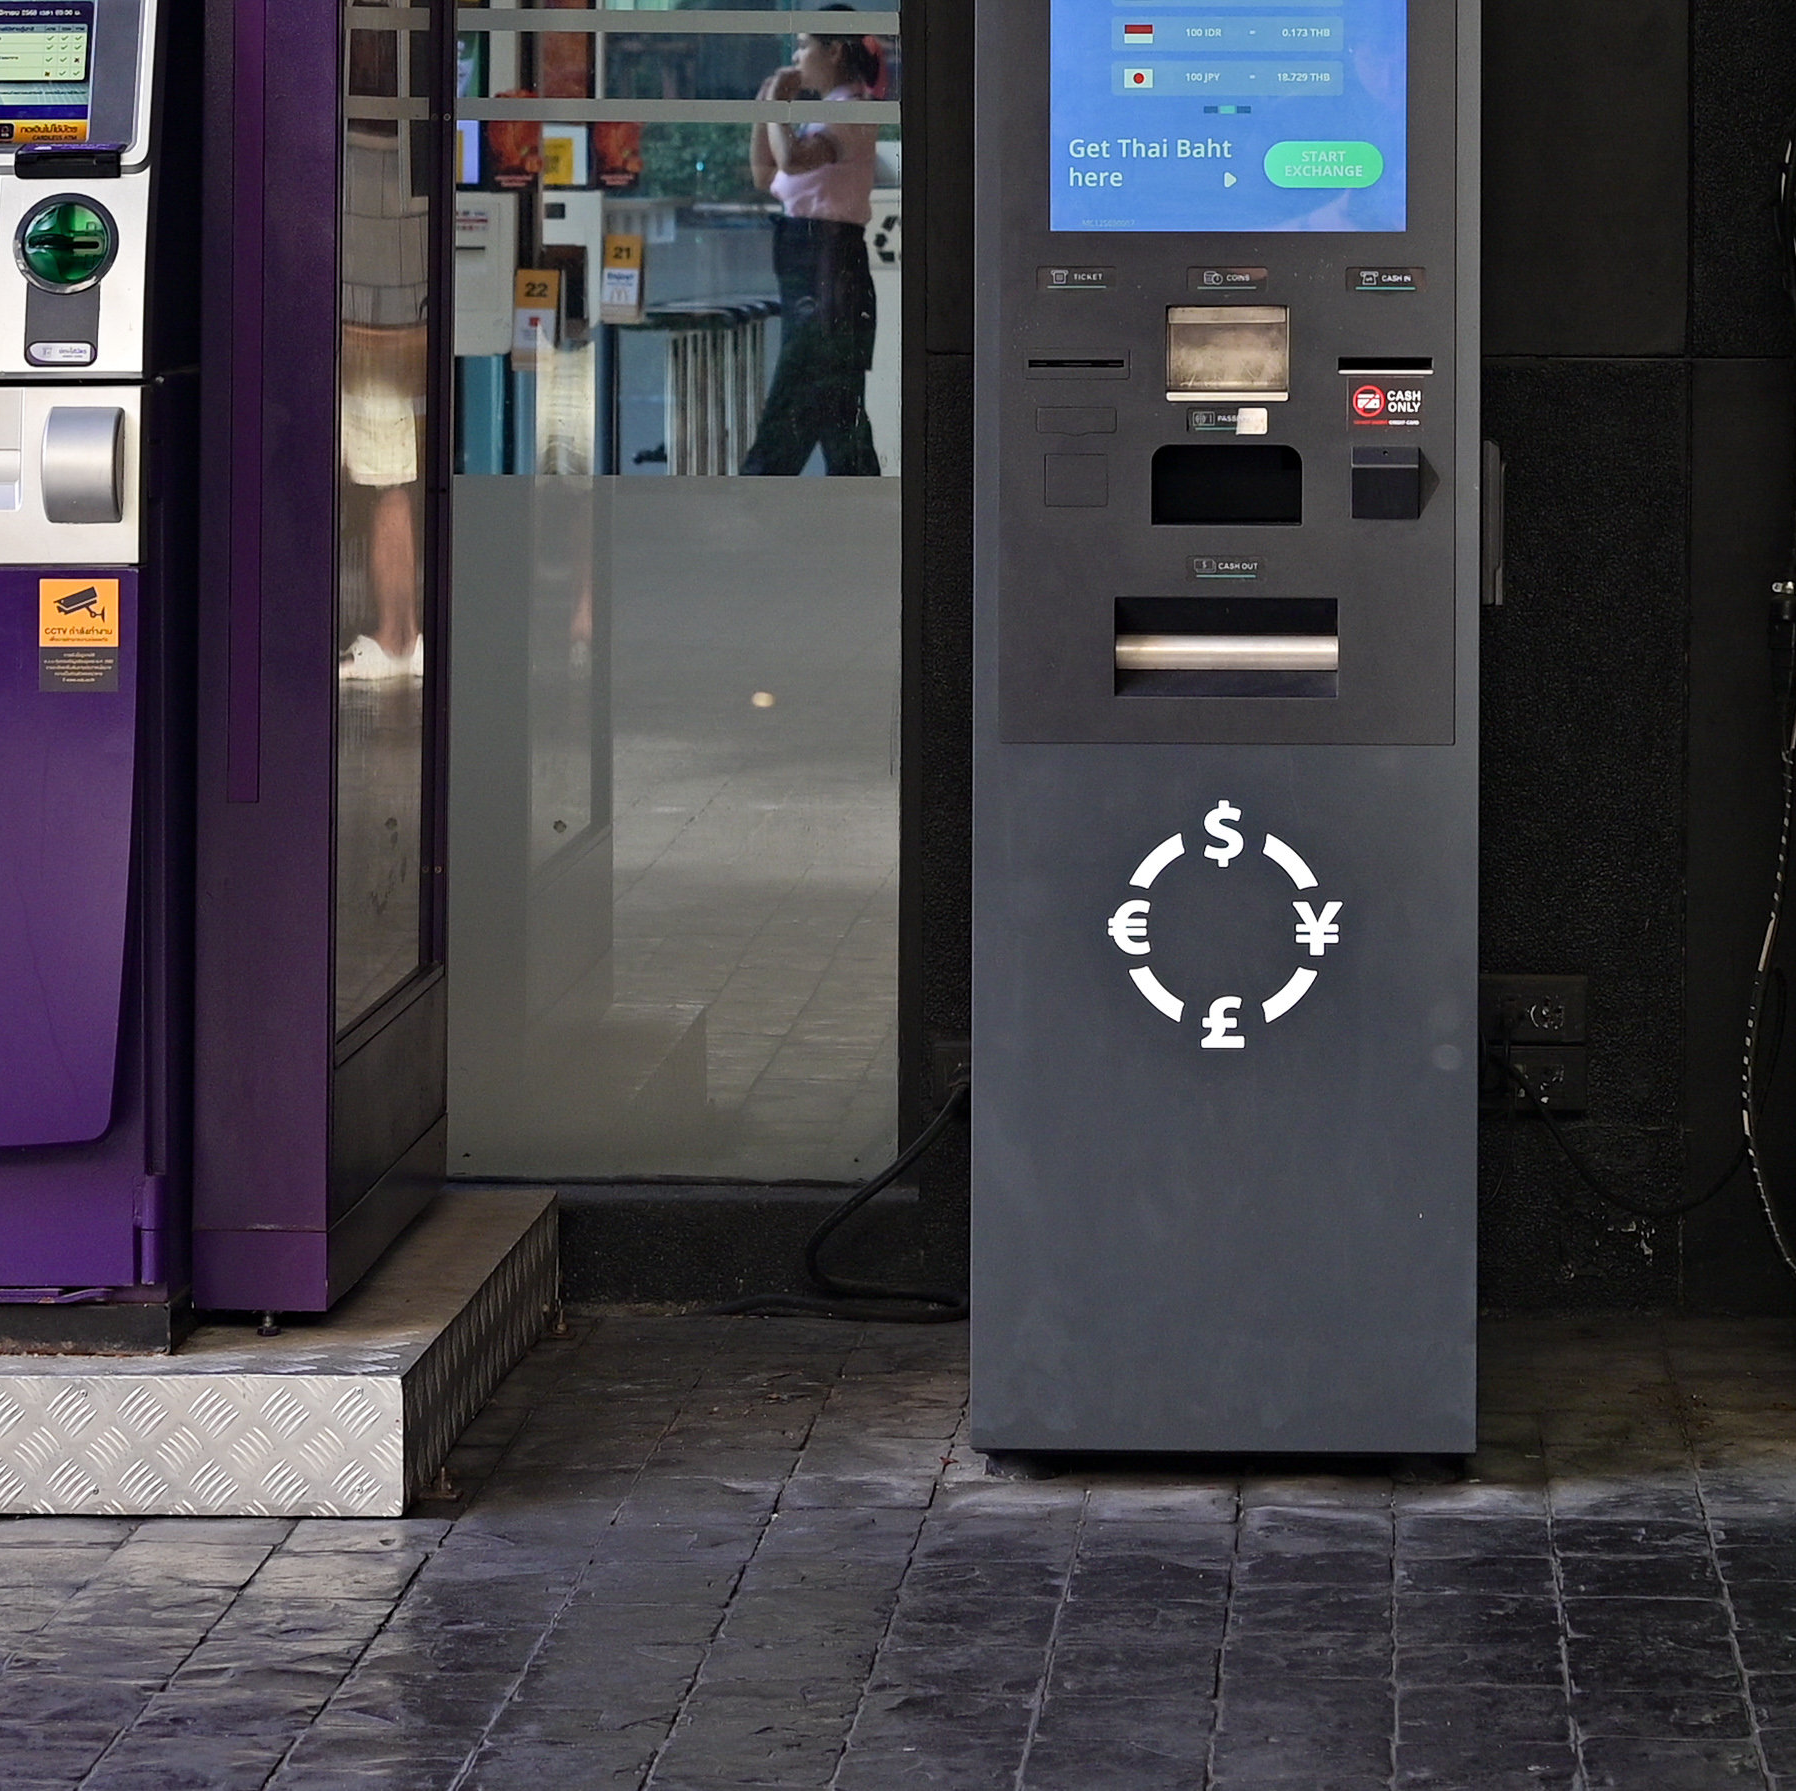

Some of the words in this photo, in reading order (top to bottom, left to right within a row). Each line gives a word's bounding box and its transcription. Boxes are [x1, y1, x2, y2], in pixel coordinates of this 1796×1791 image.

[1186, 28, 1203, 37] 100
[1205, 28, 1222, 37] IDR
[1310, 28, 1330, 37] THB
[1186, 73, 1203, 81] 100
[1204, 73, 1220, 83] JPY
[1310, 73, 1330, 81] THB
[1069, 139, 1110, 158] Get
[1117, 138, 1168, 158] Thai
[1177, 138, 1232, 158] Baht
[1301, 151, 1346, 163] START
[1284, 165, 1363, 177] EXCHANGE
[1069, 167, 1123, 187] here
[613, 247, 631, 258] 21
[1073, 273, 1103, 281] TICKET
[1226, 274, 1250, 282] COINS
[1382, 274, 1402, 282] CASH
[525, 283, 548, 297] 22
[1387, 390, 1421, 401] CASH
[1387, 402, 1421, 413] ONLY
[1218, 562, 1240, 570] CASH
[1241, 562, 1258, 570] OUT
[44, 627, 67, 635] CCTV
